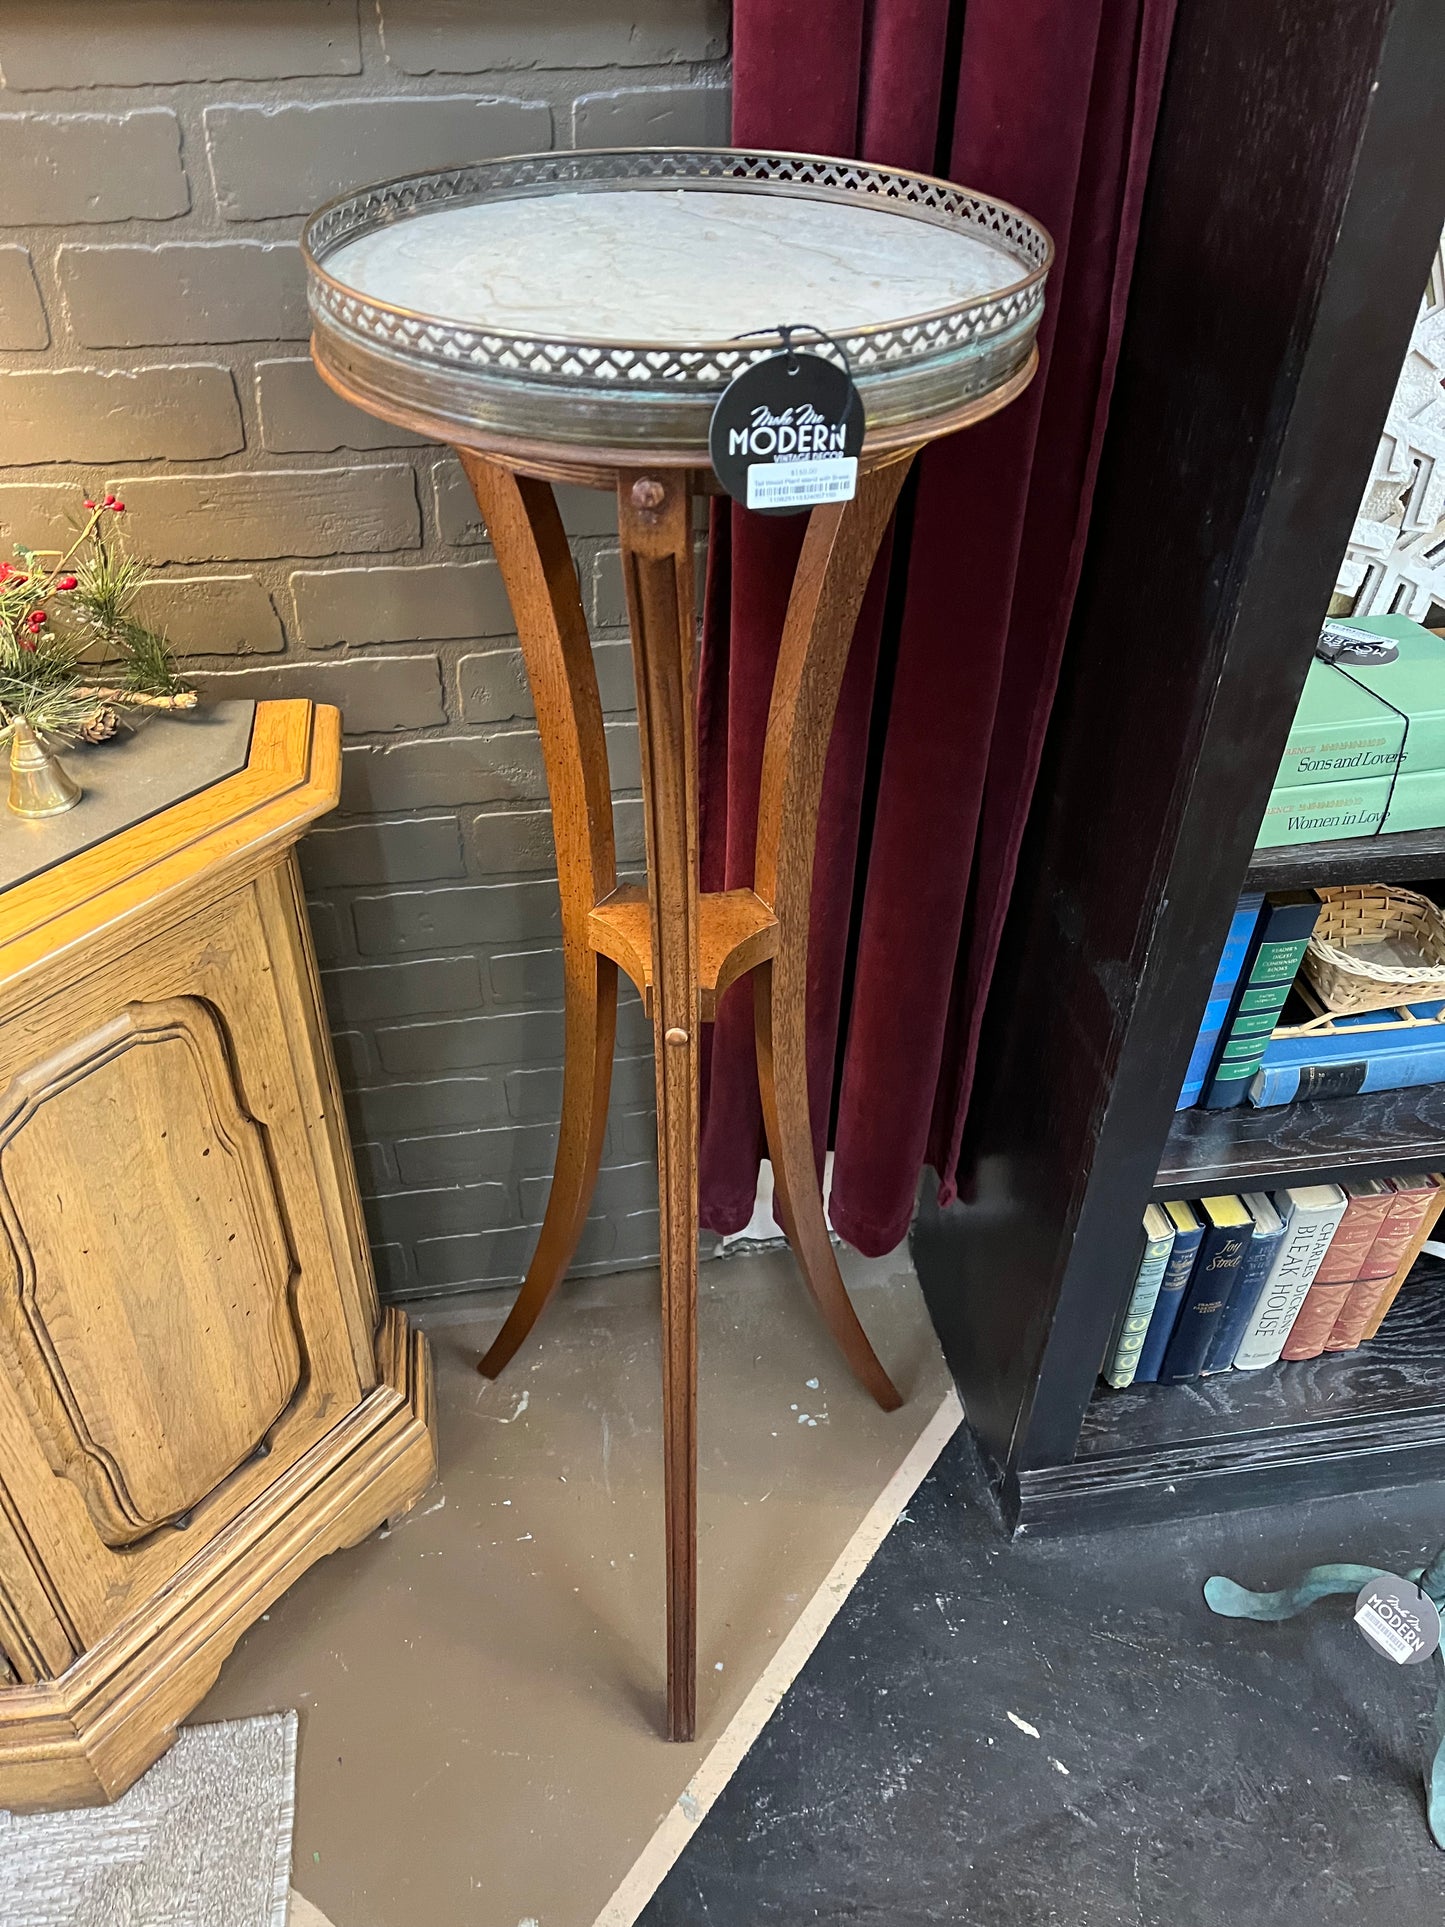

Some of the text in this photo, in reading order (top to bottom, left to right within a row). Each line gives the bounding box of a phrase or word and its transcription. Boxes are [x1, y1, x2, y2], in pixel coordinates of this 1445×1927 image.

[729, 424, 846, 455] MODERN
[1297, 751, 1409, 773] Sons and Lovers
[1288, 809, 1391, 831] Women in Love
[1205, 1255, 1243, 1272] Street
[1215, 1239, 1243, 1257] Joy
[1278, 1224, 1318, 1277] BLEAK
[1278, 1222, 1335, 1335] CHARLES DICKENS
[1254, 1283, 1293, 1337] HOUSE
[1367, 1593, 1425, 1652] MODERN
